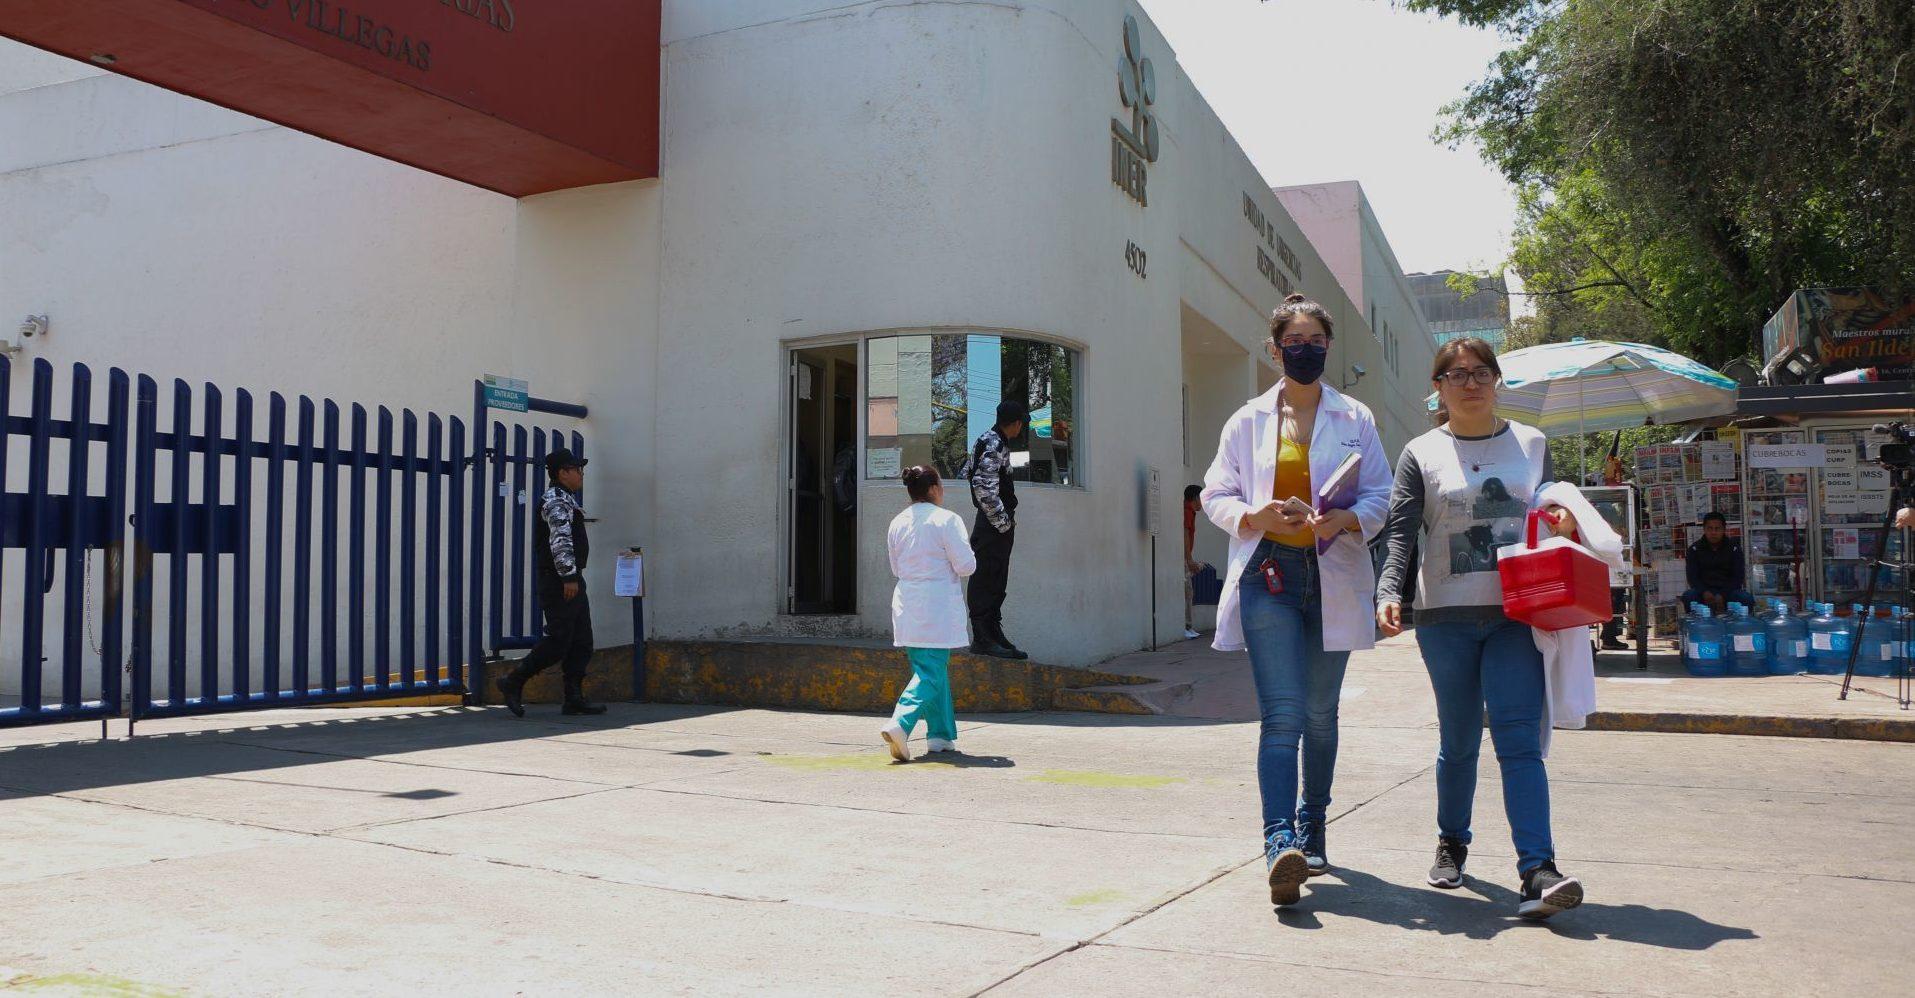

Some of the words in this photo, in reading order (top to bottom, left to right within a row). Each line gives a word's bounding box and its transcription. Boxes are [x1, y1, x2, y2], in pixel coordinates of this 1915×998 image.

[286, 0, 432, 71] VILLEGAS
[1125, 238, 1147, 280] 4502
[1832, 328, 1880, 338] Maestros
[1822, 343, 1860, 358] San
[1868, 337, 1914, 357] Ilde
[494, 389, 519, 400] ENTRADA
[1752, 449, 1807, 458] CUBREBOCAS
[1860, 471, 1883, 479] IMSS
